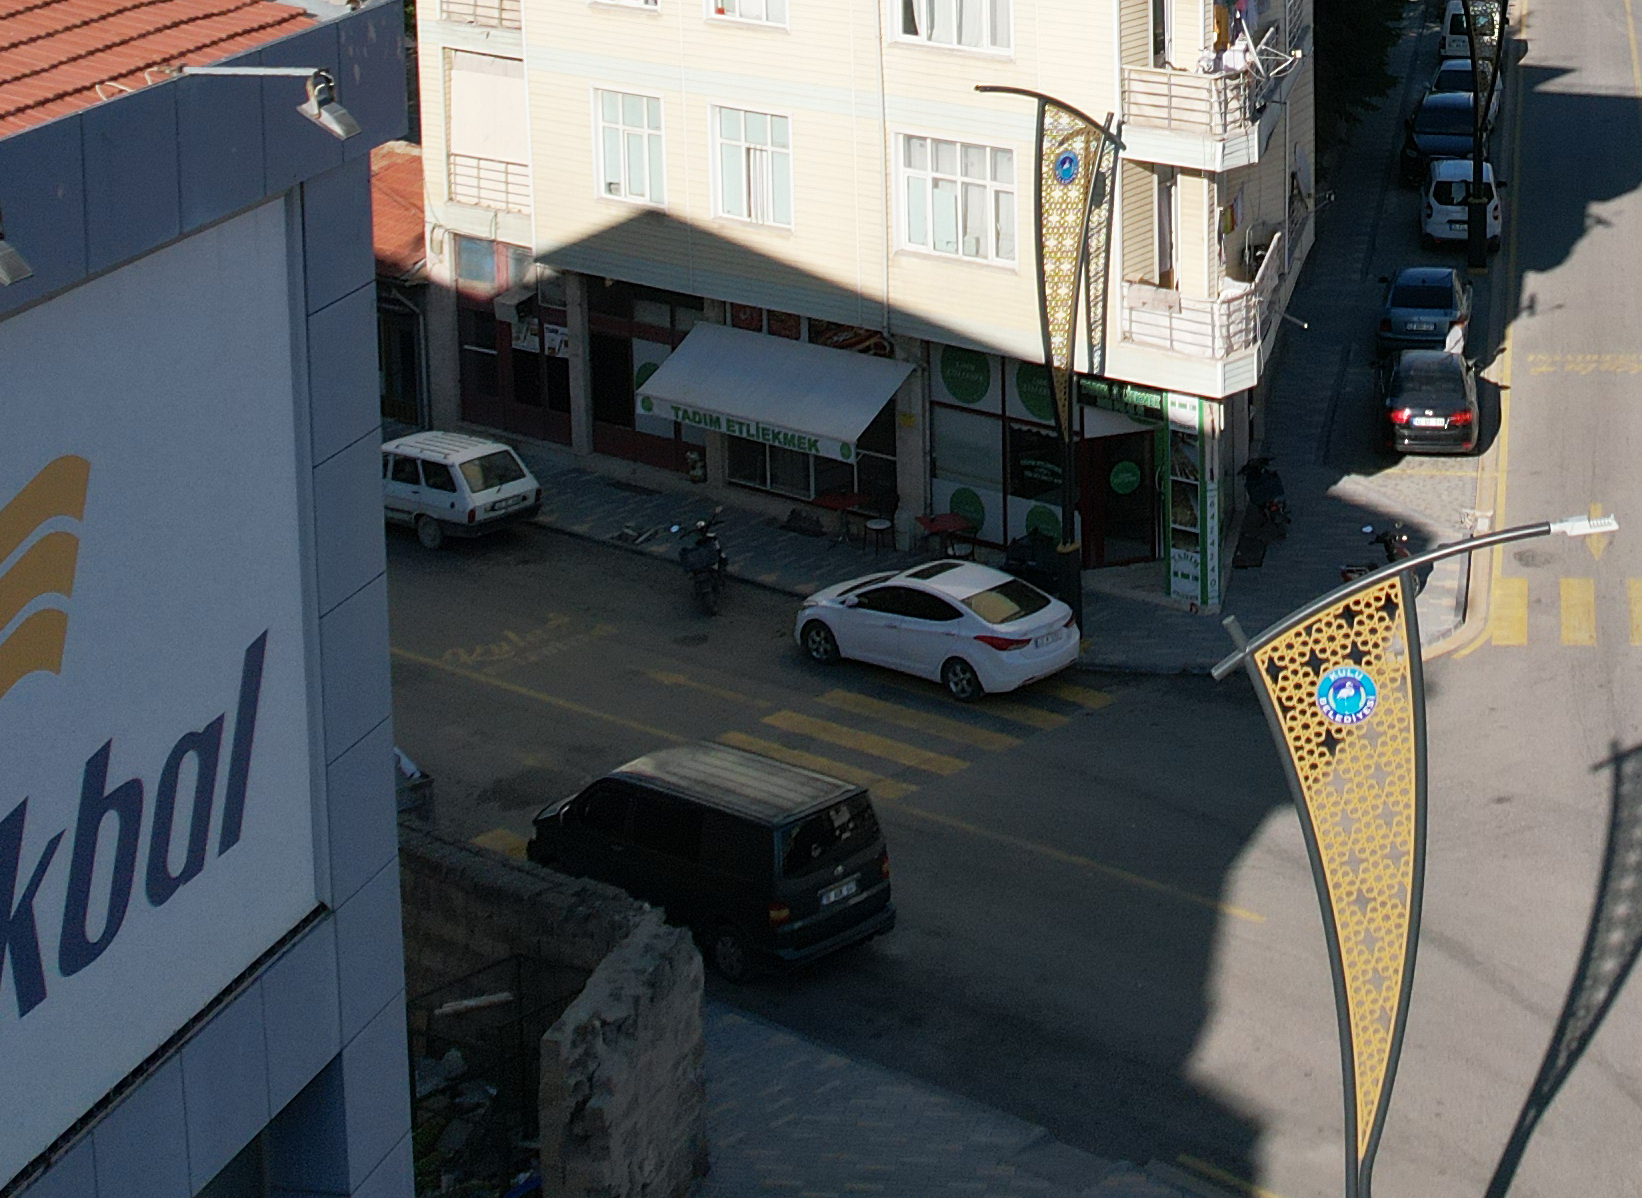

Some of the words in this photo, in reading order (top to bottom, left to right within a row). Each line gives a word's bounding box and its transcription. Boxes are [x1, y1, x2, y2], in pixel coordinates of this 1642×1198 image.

[671, 405, 721, 429] TADIM
[726, 418, 820, 453] ETLİEKMEK
[1328, 668, 1364, 681] KULU
[1319, 695, 1376, 724] BELEDİYESİ
